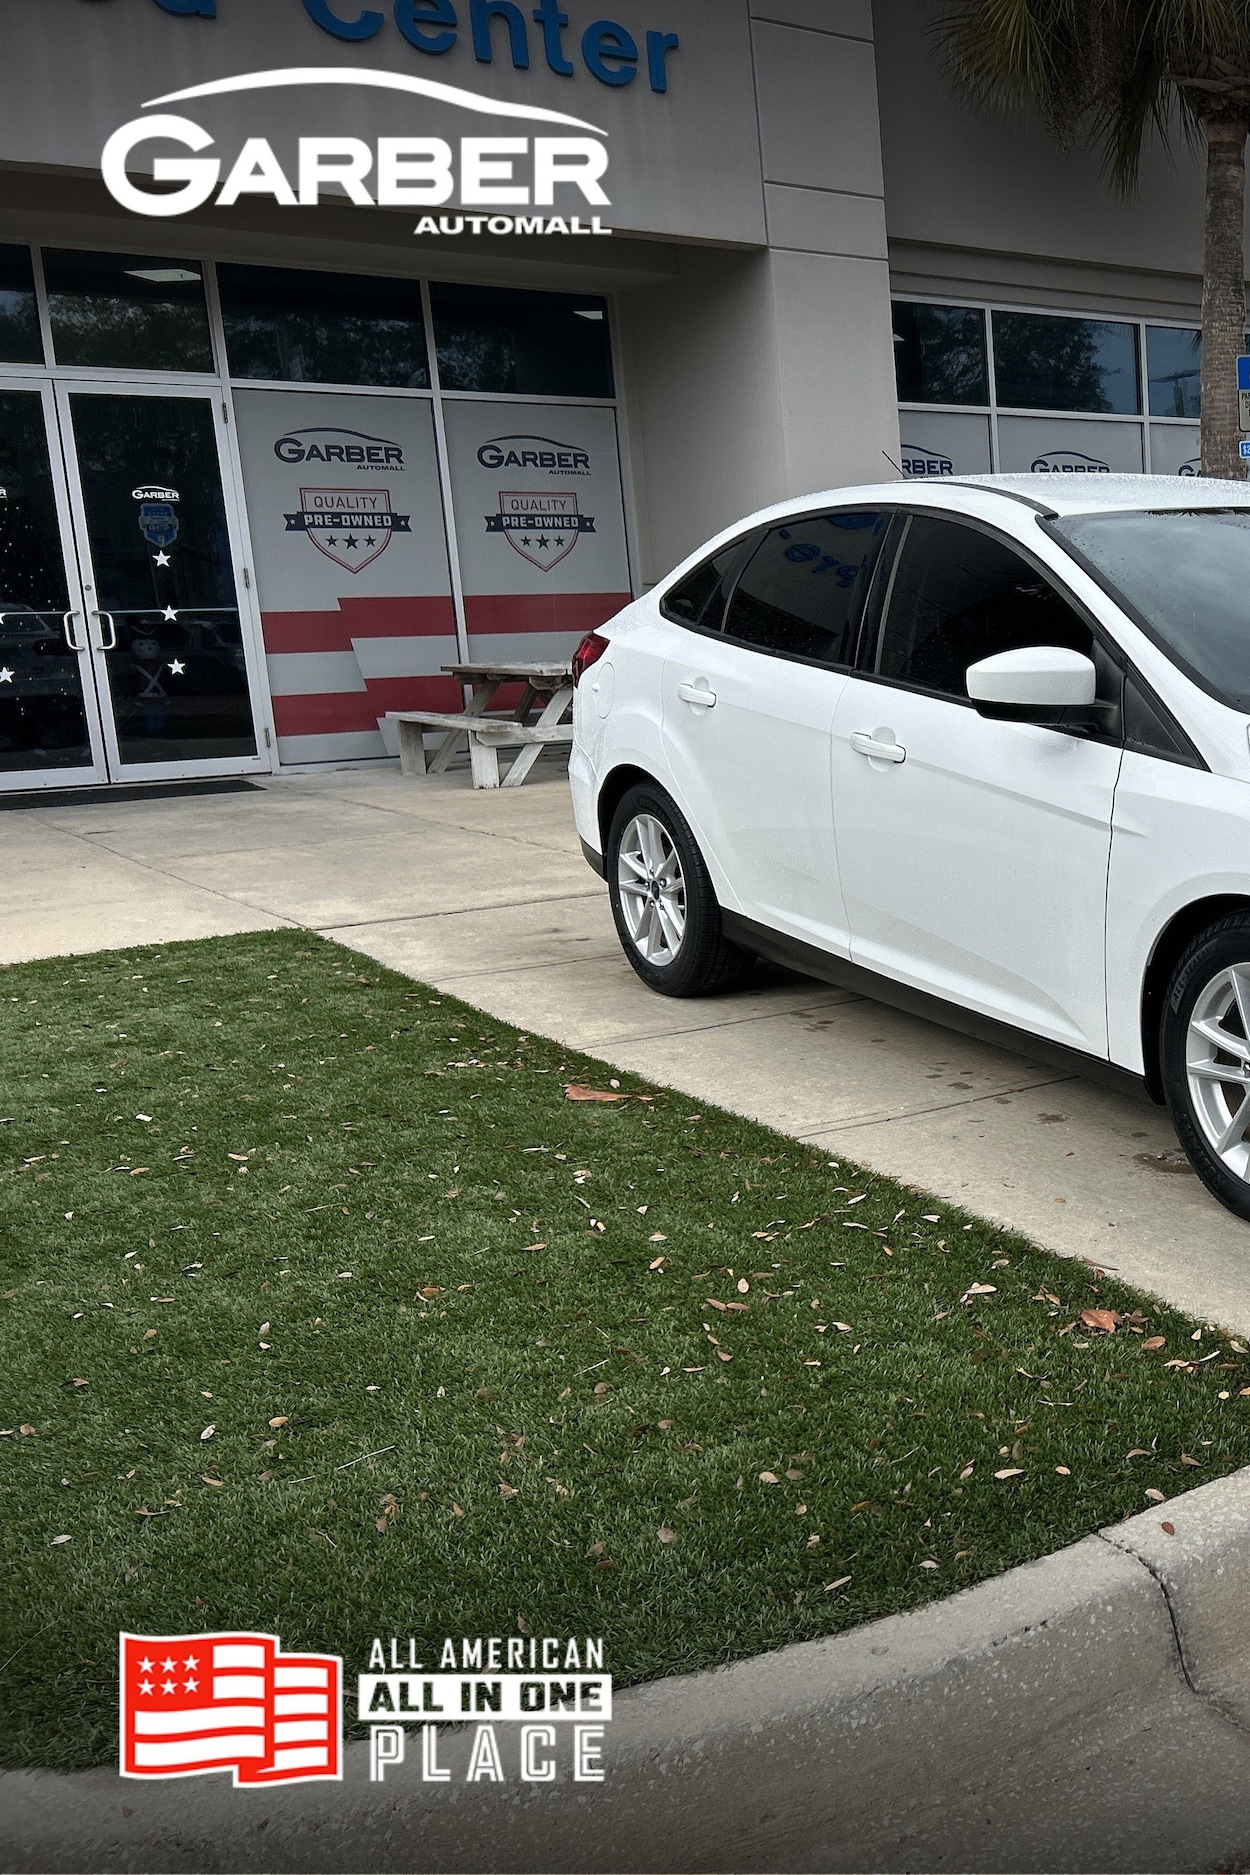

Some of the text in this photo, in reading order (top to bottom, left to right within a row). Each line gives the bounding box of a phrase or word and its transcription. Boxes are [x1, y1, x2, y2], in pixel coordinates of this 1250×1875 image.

[273, 437, 405, 464] GARBER
[477, 444, 590, 469] GARBER
[356, 464, 406, 472] AUTOMALL
[901, 459, 953, 475] RBER
[132, 490, 180, 500] GARBER
[313, 496, 377, 509] QUALITY
[511, 499, 567, 512] QUALITY
[303, 514, 392, 527] PRE-OWNED
[502, 516, 579, 528] PRE-OWNED
